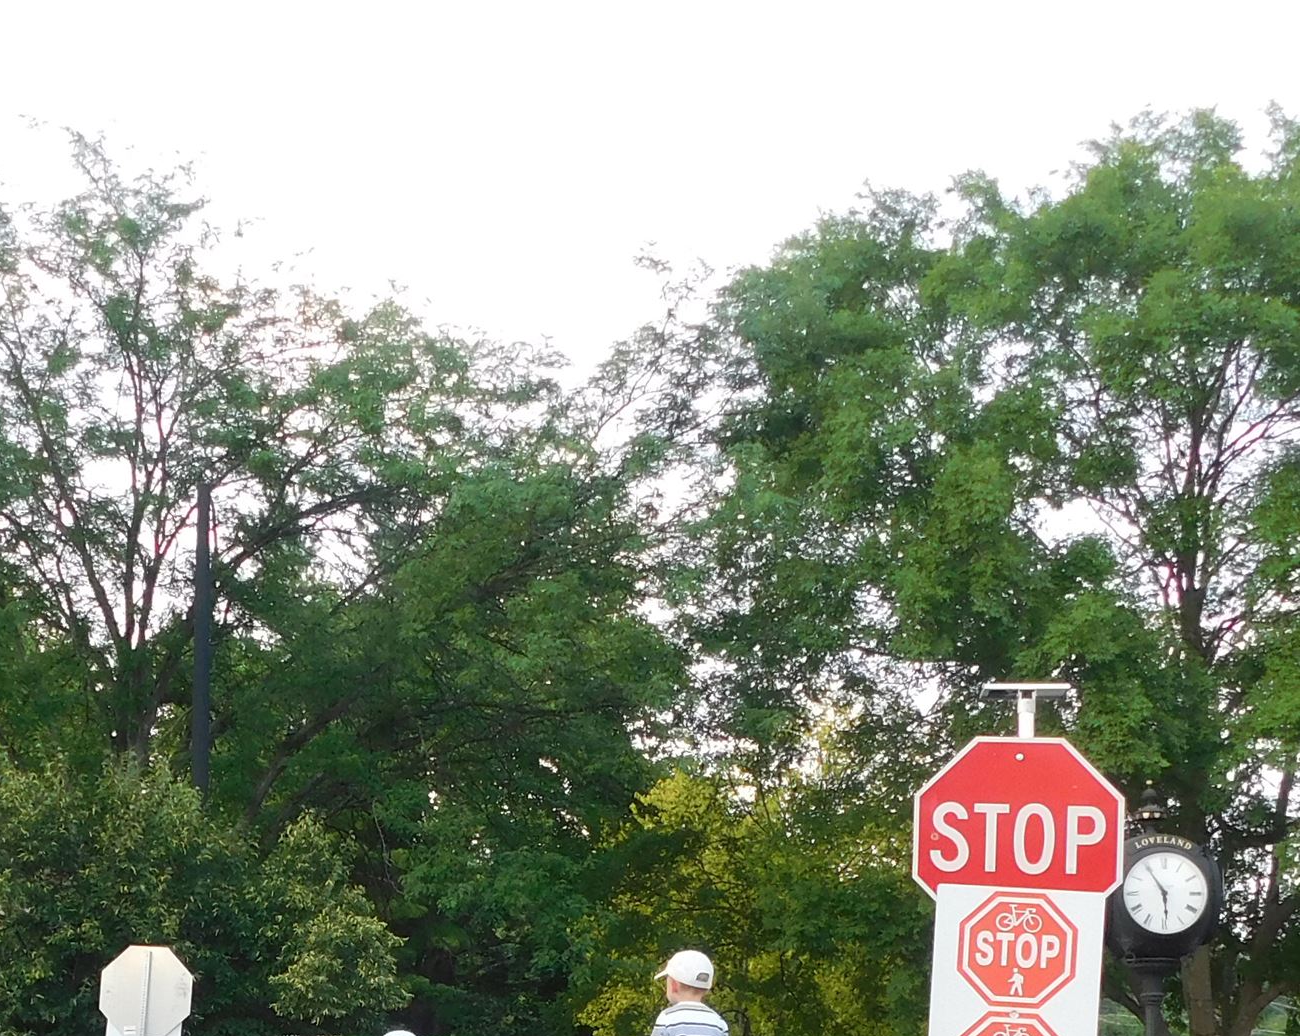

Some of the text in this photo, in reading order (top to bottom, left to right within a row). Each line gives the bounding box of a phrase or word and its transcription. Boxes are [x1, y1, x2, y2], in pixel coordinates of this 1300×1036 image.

[929, 801, 1107, 875] STOP
[1134, 836, 1192, 850] LOVELAND
[974, 930, 1061, 969] STOP
